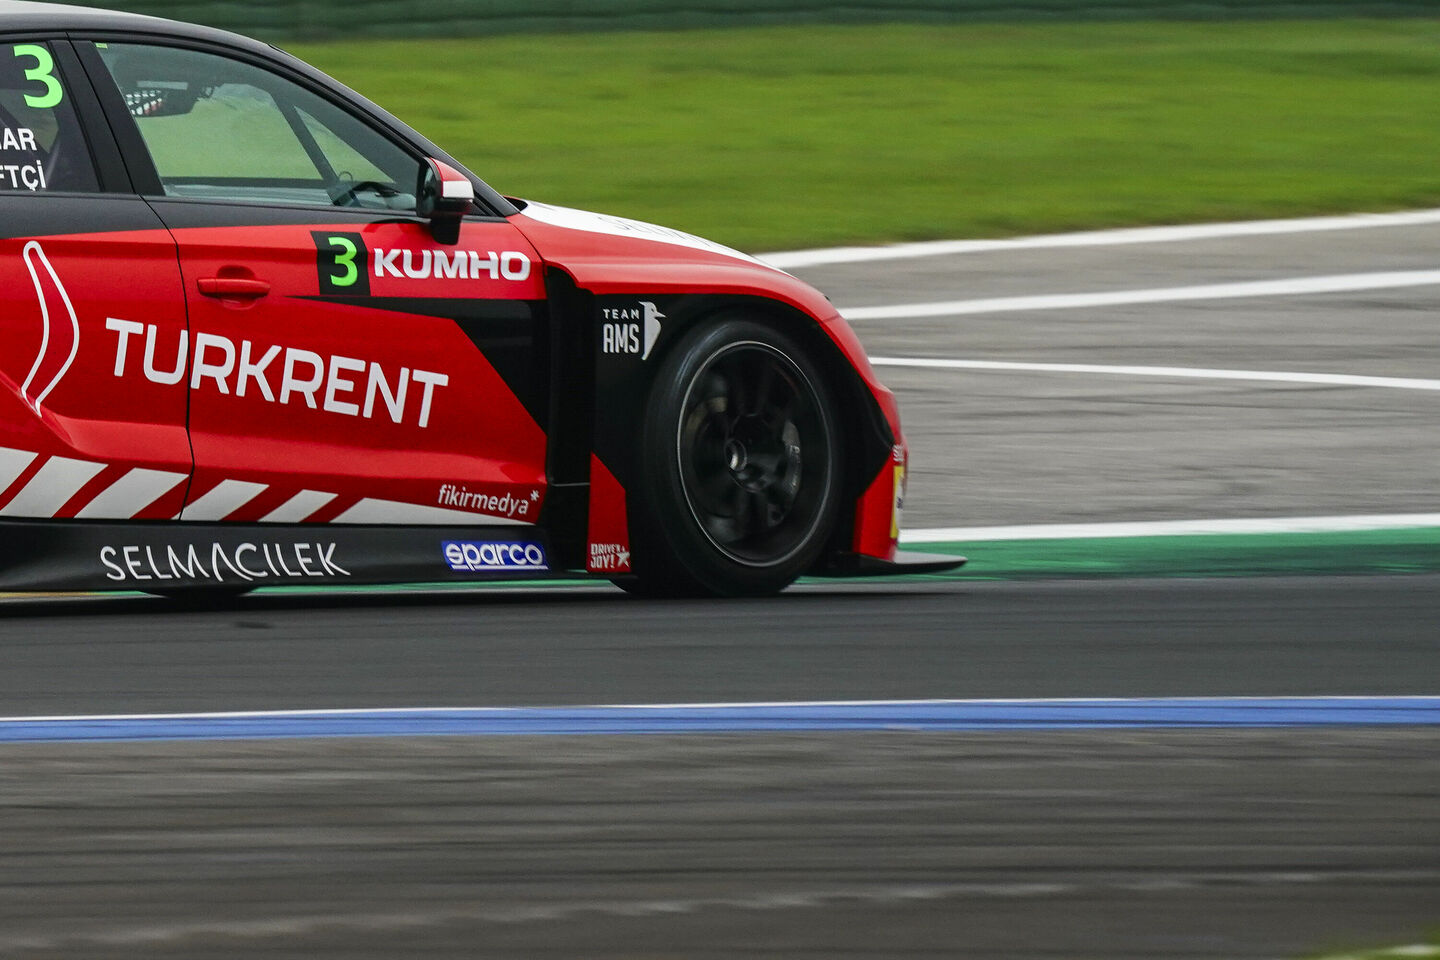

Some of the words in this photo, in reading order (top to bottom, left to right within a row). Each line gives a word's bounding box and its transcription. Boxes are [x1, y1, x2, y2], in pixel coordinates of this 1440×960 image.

[13, 44, 63, 108] 3
[327, 237, 358, 287] 3
[374, 248, 530, 281] KUMHO
[603, 323, 640, 353] AMS
[105, 317, 449, 428] TURKRENT
[100, 542, 350, 582] SELMACILEK
[445, 543, 544, 571] sparco
